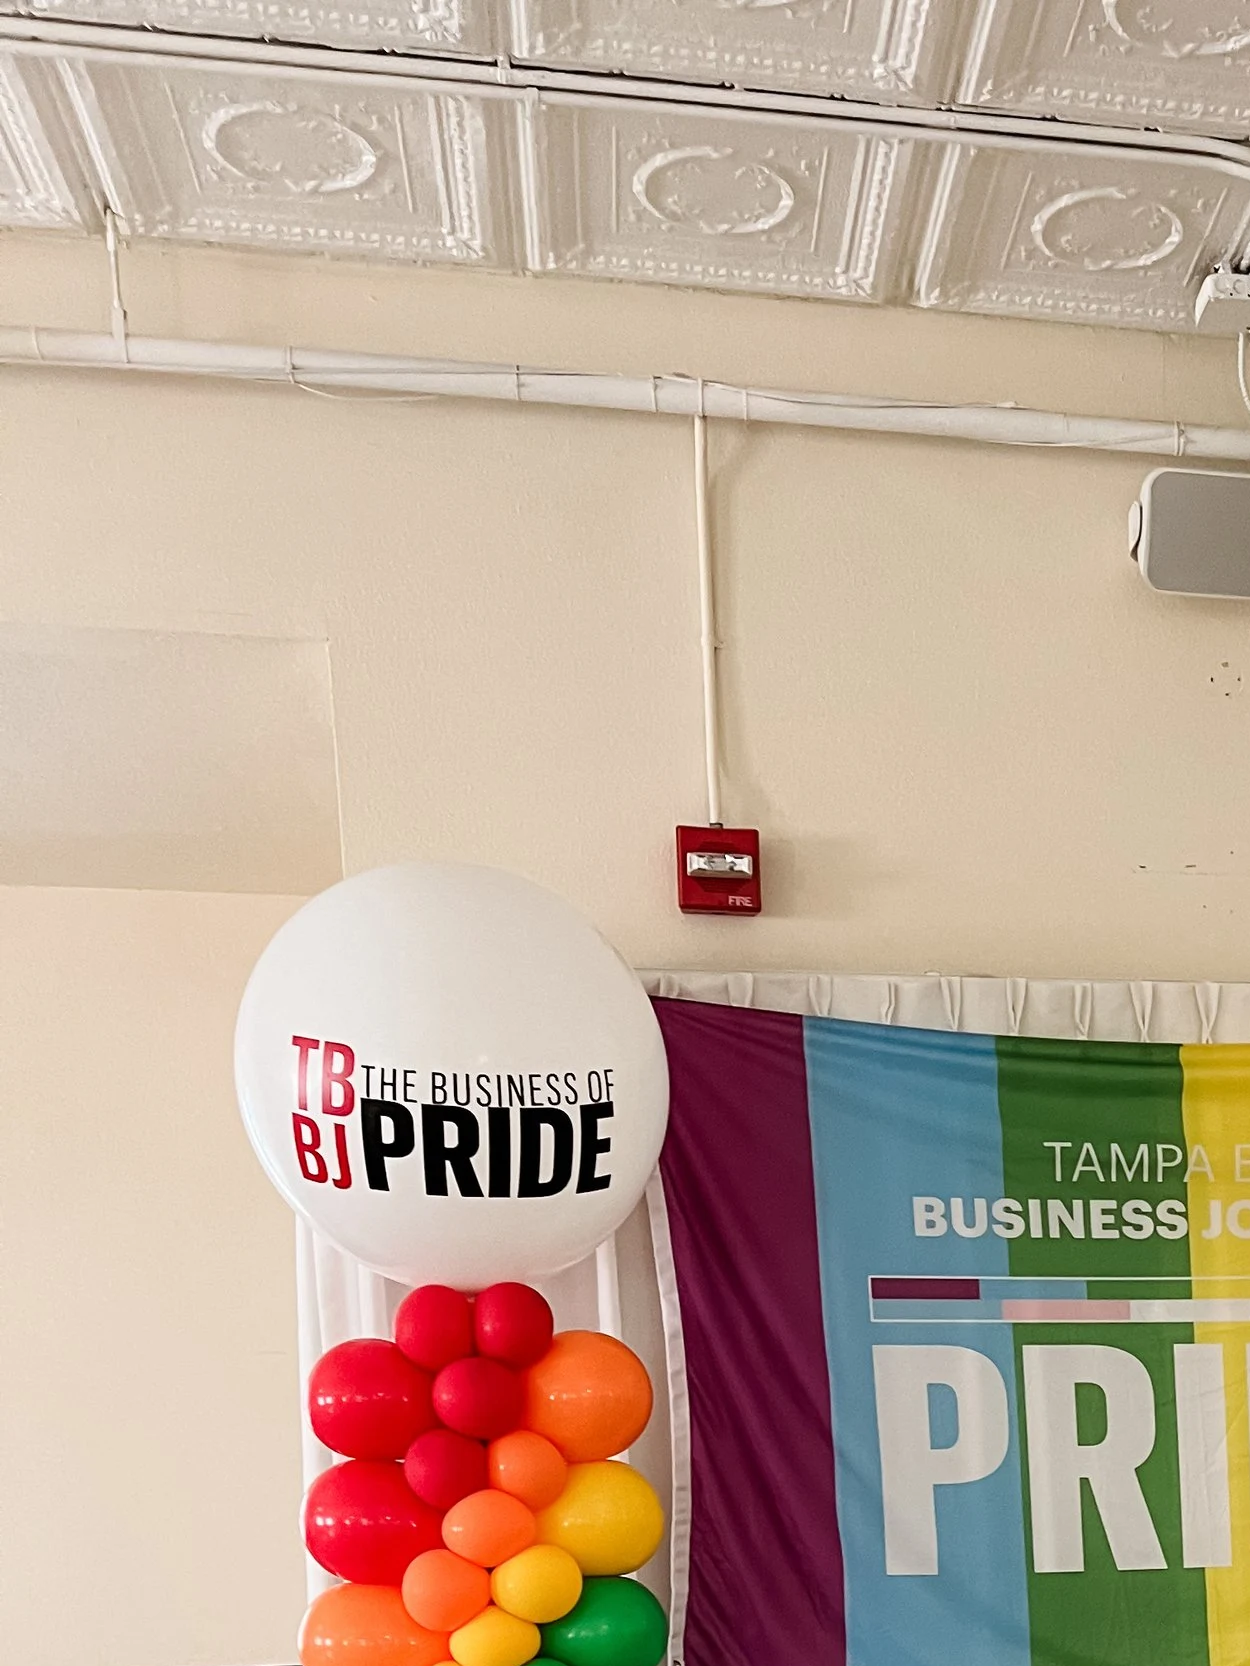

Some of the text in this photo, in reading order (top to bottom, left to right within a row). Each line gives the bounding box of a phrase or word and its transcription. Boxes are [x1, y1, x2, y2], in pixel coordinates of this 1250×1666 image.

[728, 895, 753, 907] FIRE
[292, 1035, 355, 1117] TB
[361, 1065, 614, 1107] THE BUSINESS OF
[292, 1112, 352, 1190] BJ
[360, 1098, 614, 1198] PRIDE
[1044, 1141, 1214, 1184] TAMPA
[912, 1196, 1188, 1240] BUSINESS
